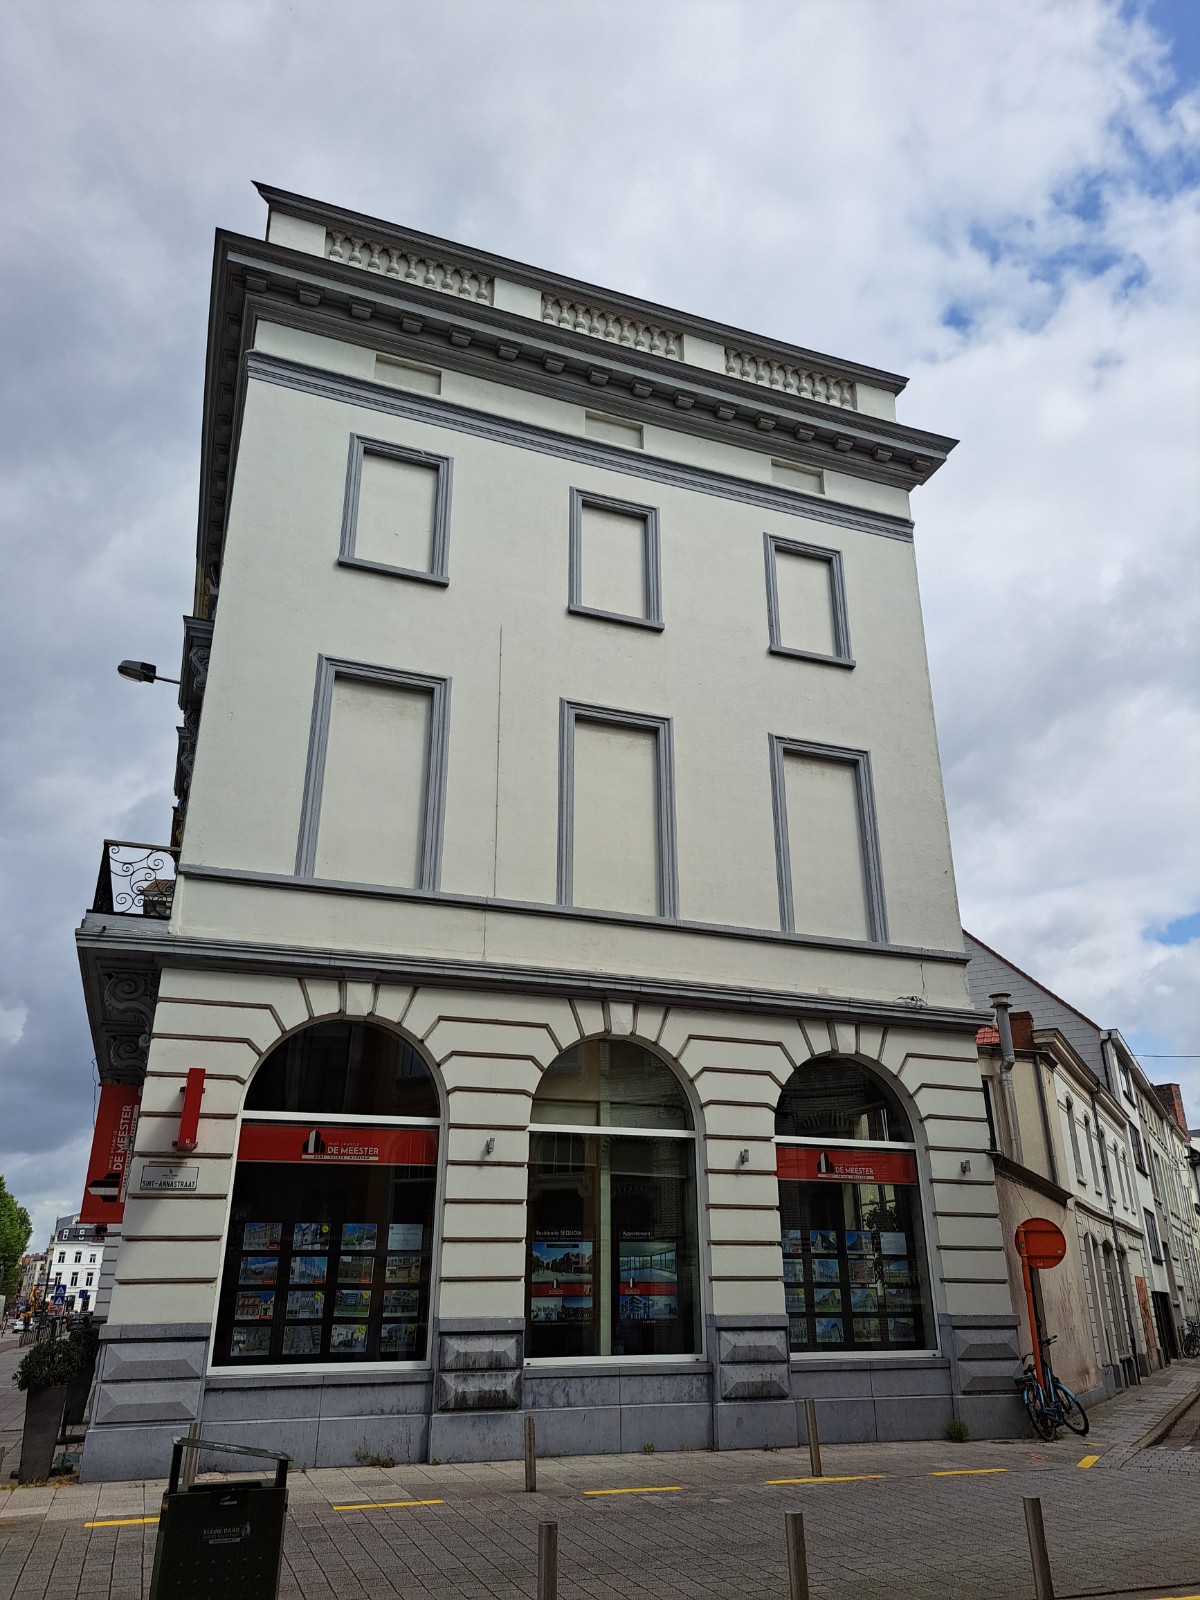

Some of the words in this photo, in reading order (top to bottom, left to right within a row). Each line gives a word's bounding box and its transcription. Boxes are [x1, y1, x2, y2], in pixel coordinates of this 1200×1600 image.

[117, 1105, 132, 1152] MEESTER
[340, 1147, 379, 1155] MEESTER
[113, 1155, 124, 1171] DE
[142, 1180, 196, 1188] SINT-ANNASTRAAT
